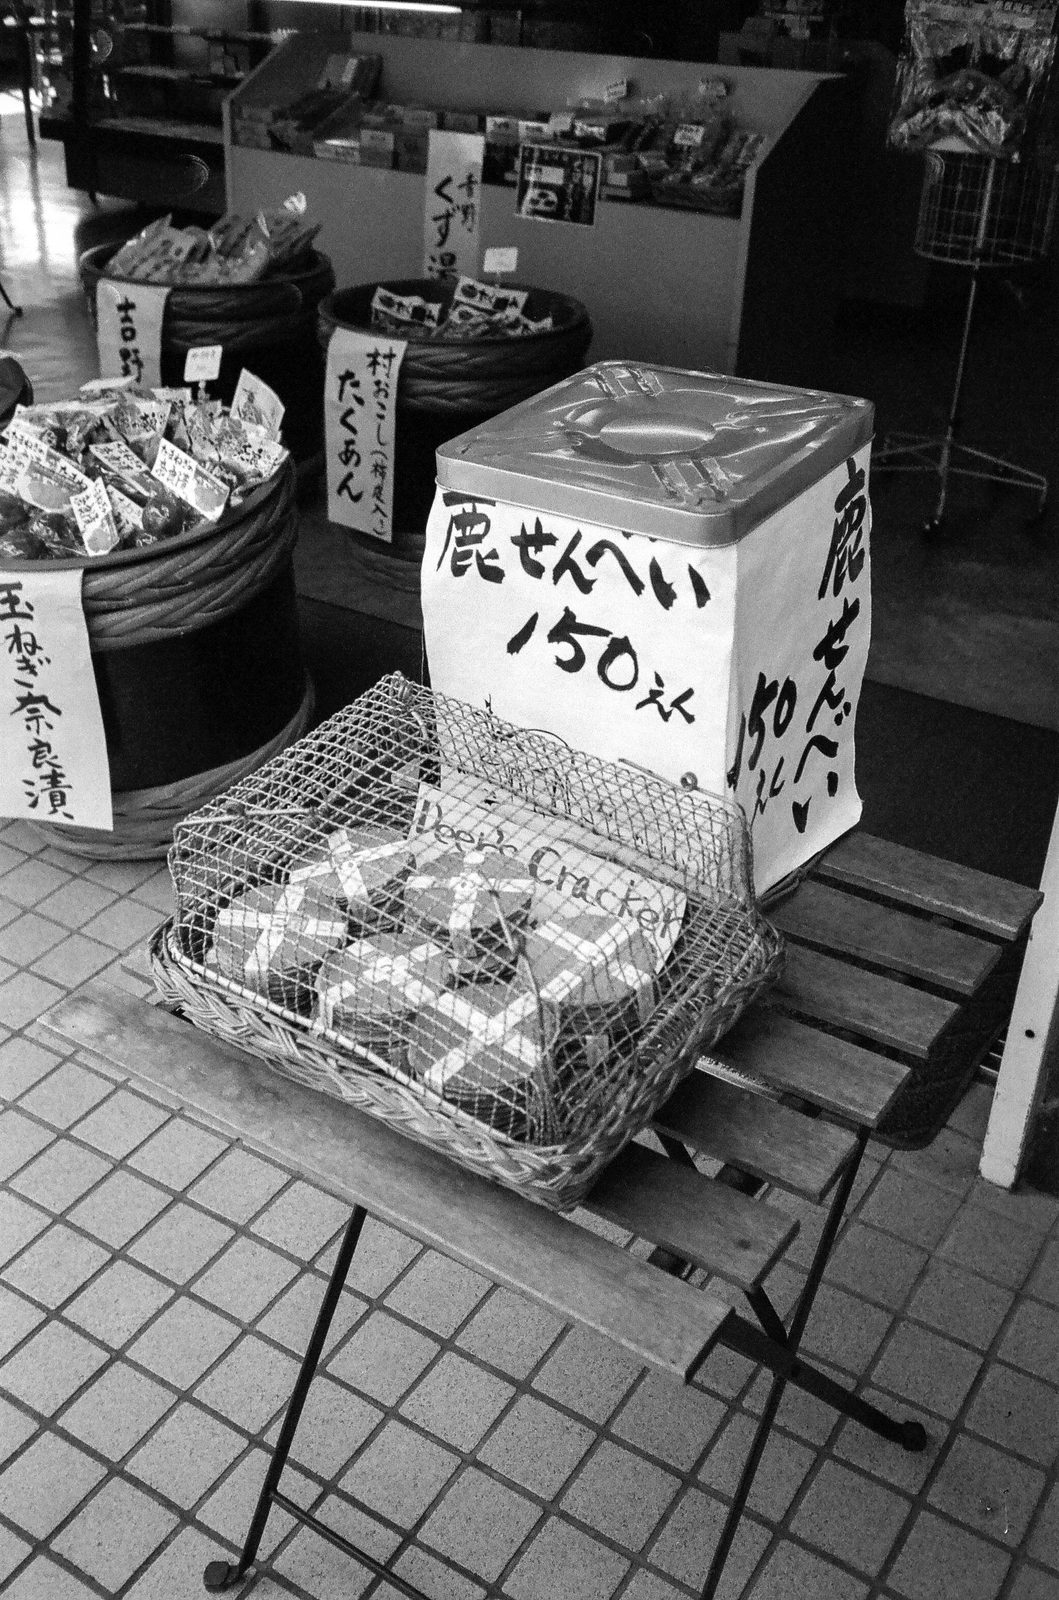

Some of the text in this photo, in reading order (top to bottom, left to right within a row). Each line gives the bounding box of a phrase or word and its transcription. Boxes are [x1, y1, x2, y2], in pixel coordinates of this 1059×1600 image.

[337, 369, 365, 503] たくあん
[436, 491, 712, 611] 鹿せんべい
[0, 582, 75, 820] 玉ねぎ奈良漬
[792, 457, 867, 834] 鹿せんべい
[528, 846, 685, 939] Cracker
